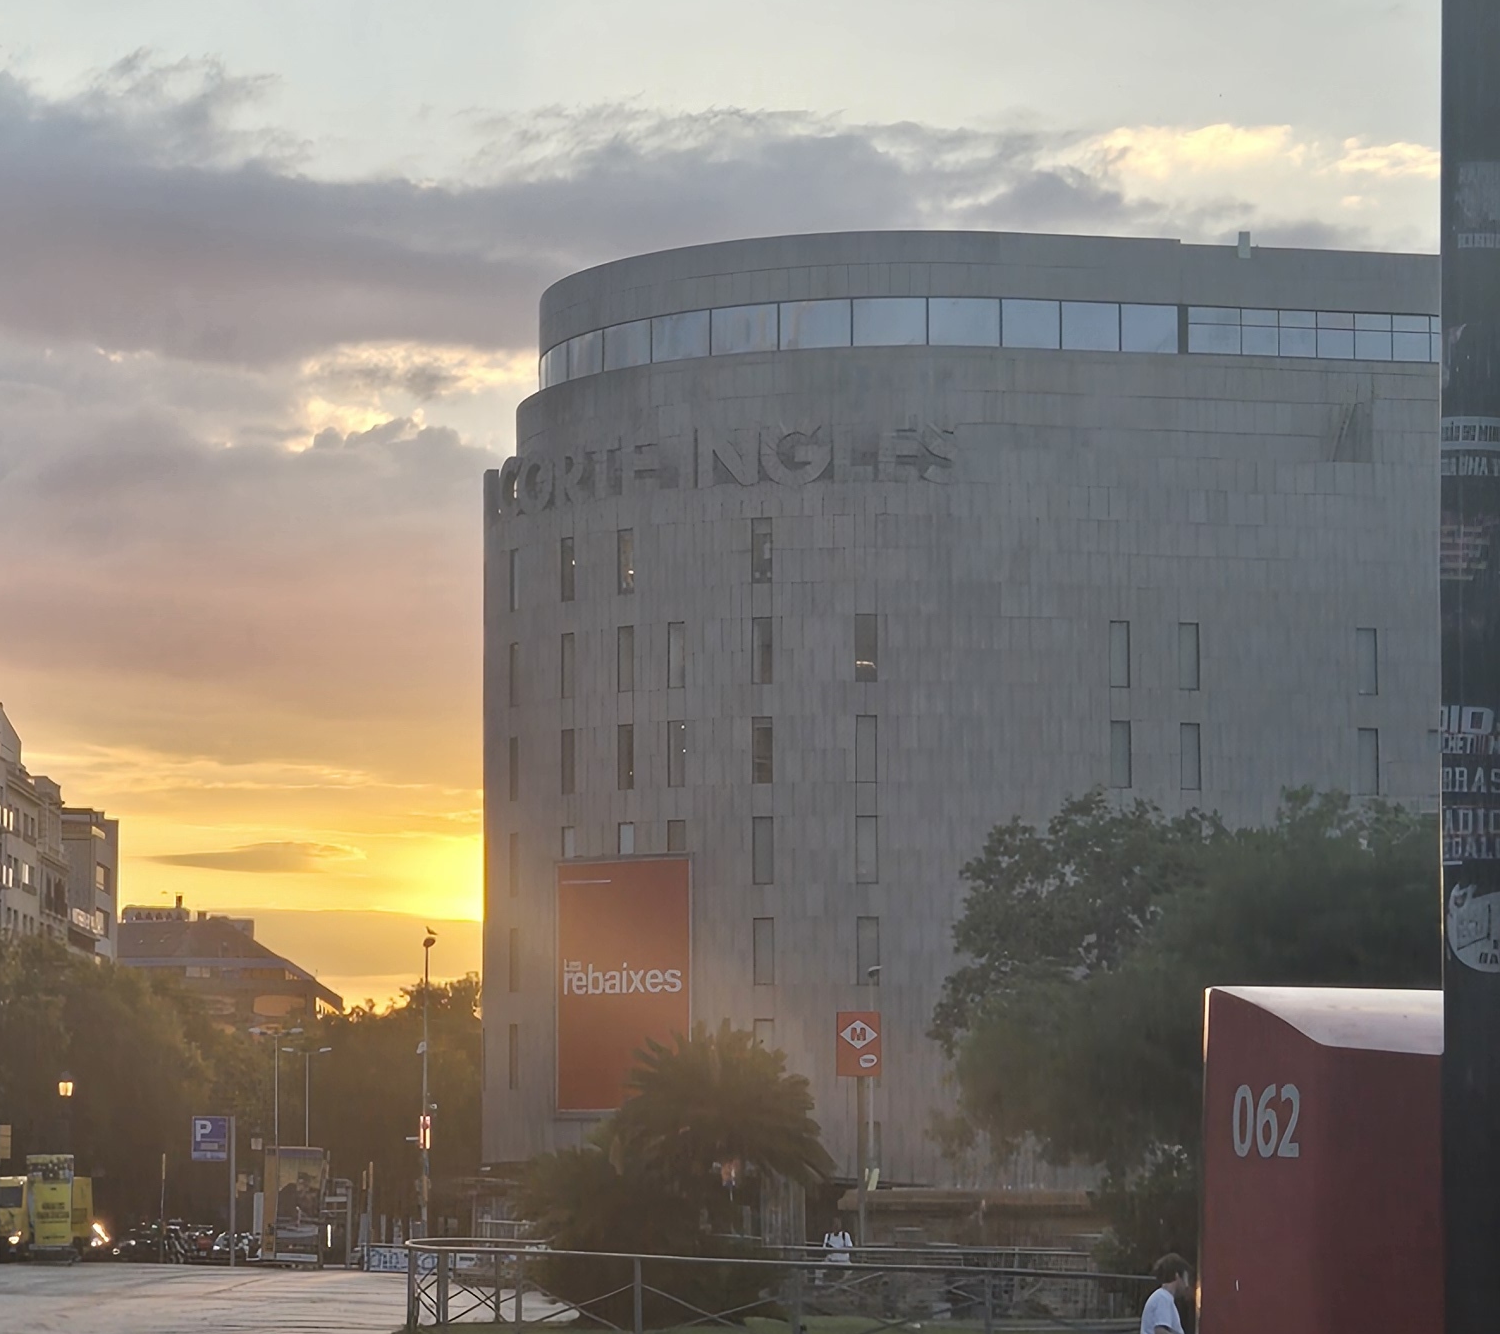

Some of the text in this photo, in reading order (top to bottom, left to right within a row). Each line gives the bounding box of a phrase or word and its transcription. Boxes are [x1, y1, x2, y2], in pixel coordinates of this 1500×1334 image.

[564, 961, 683, 996] rebaixes
[195, 1120, 212, 1142] P
[1232, 1083, 1301, 1158] 062
